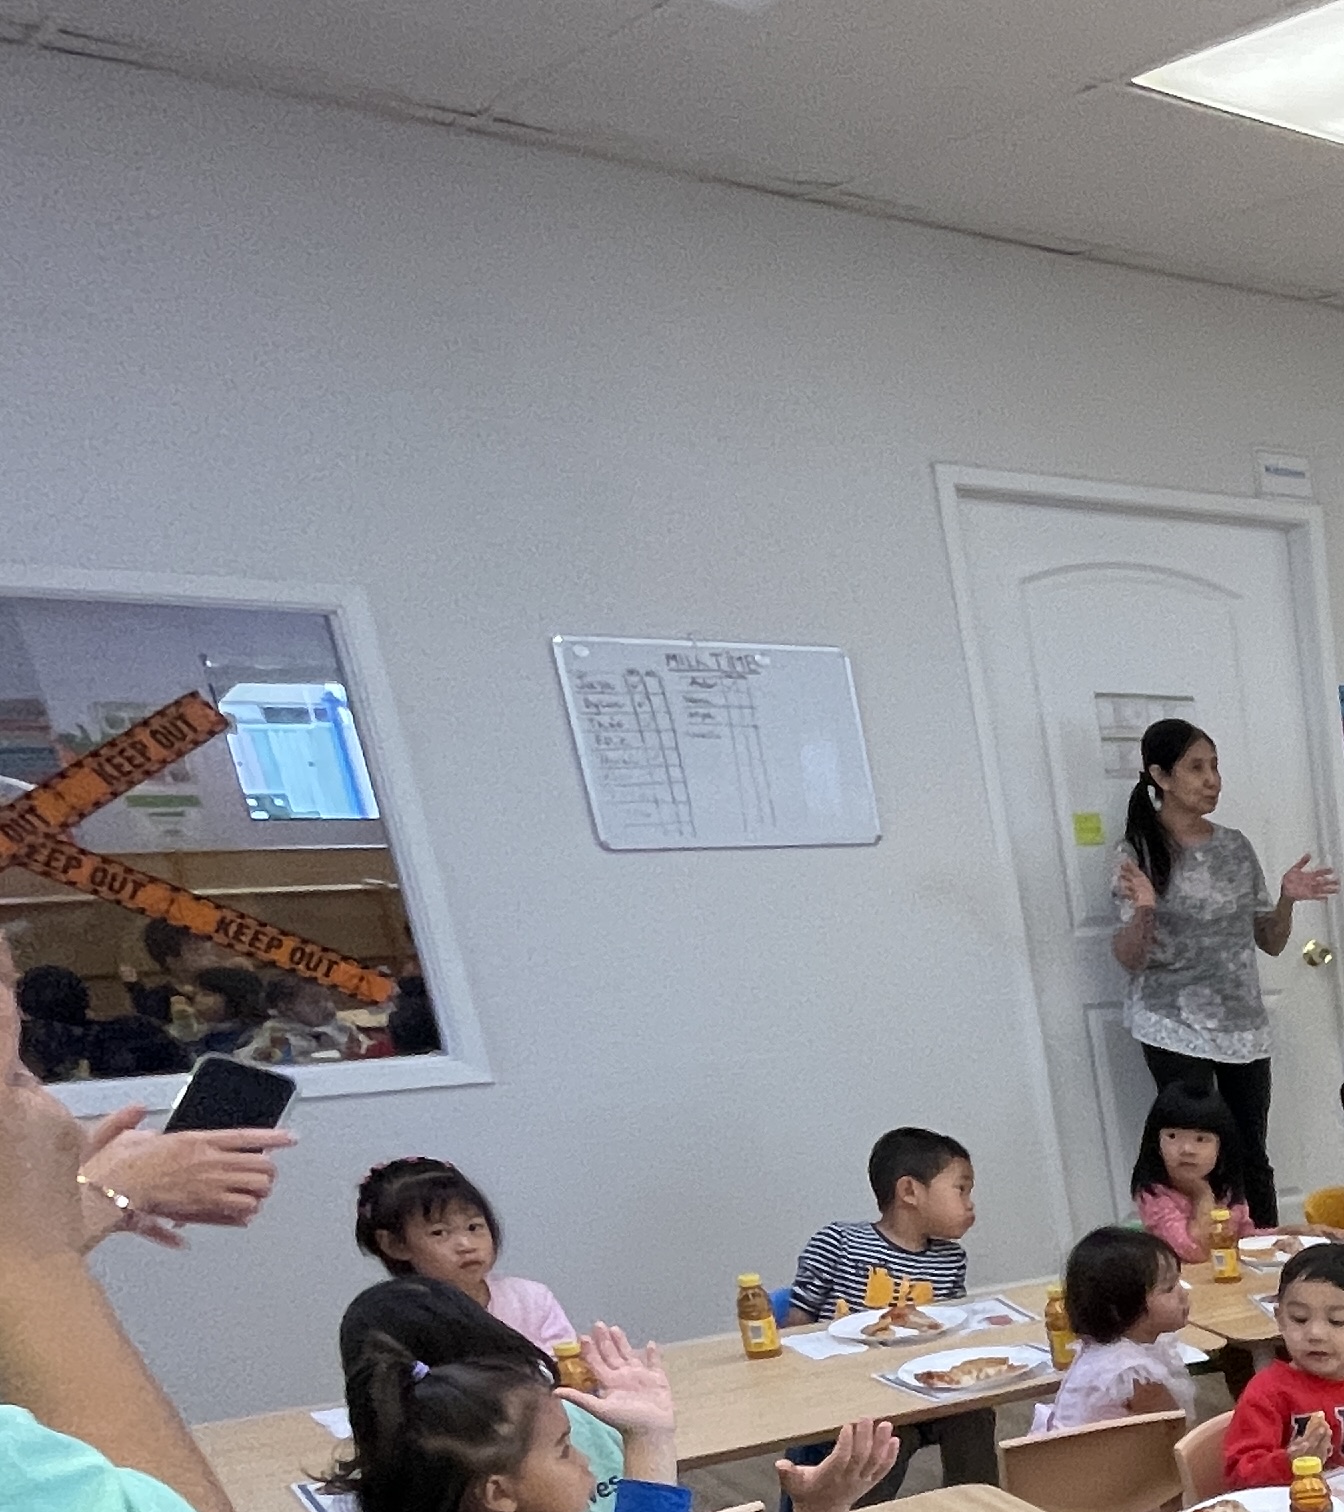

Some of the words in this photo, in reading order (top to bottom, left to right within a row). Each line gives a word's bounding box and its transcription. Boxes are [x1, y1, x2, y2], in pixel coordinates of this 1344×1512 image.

[91, 740, 151, 786] KEEP
[149, 712, 198, 749] OUT
[90, 865, 146, 900] OUT
[215, 916, 283, 953] KEEP
[290, 946, 339, 978] OUT
